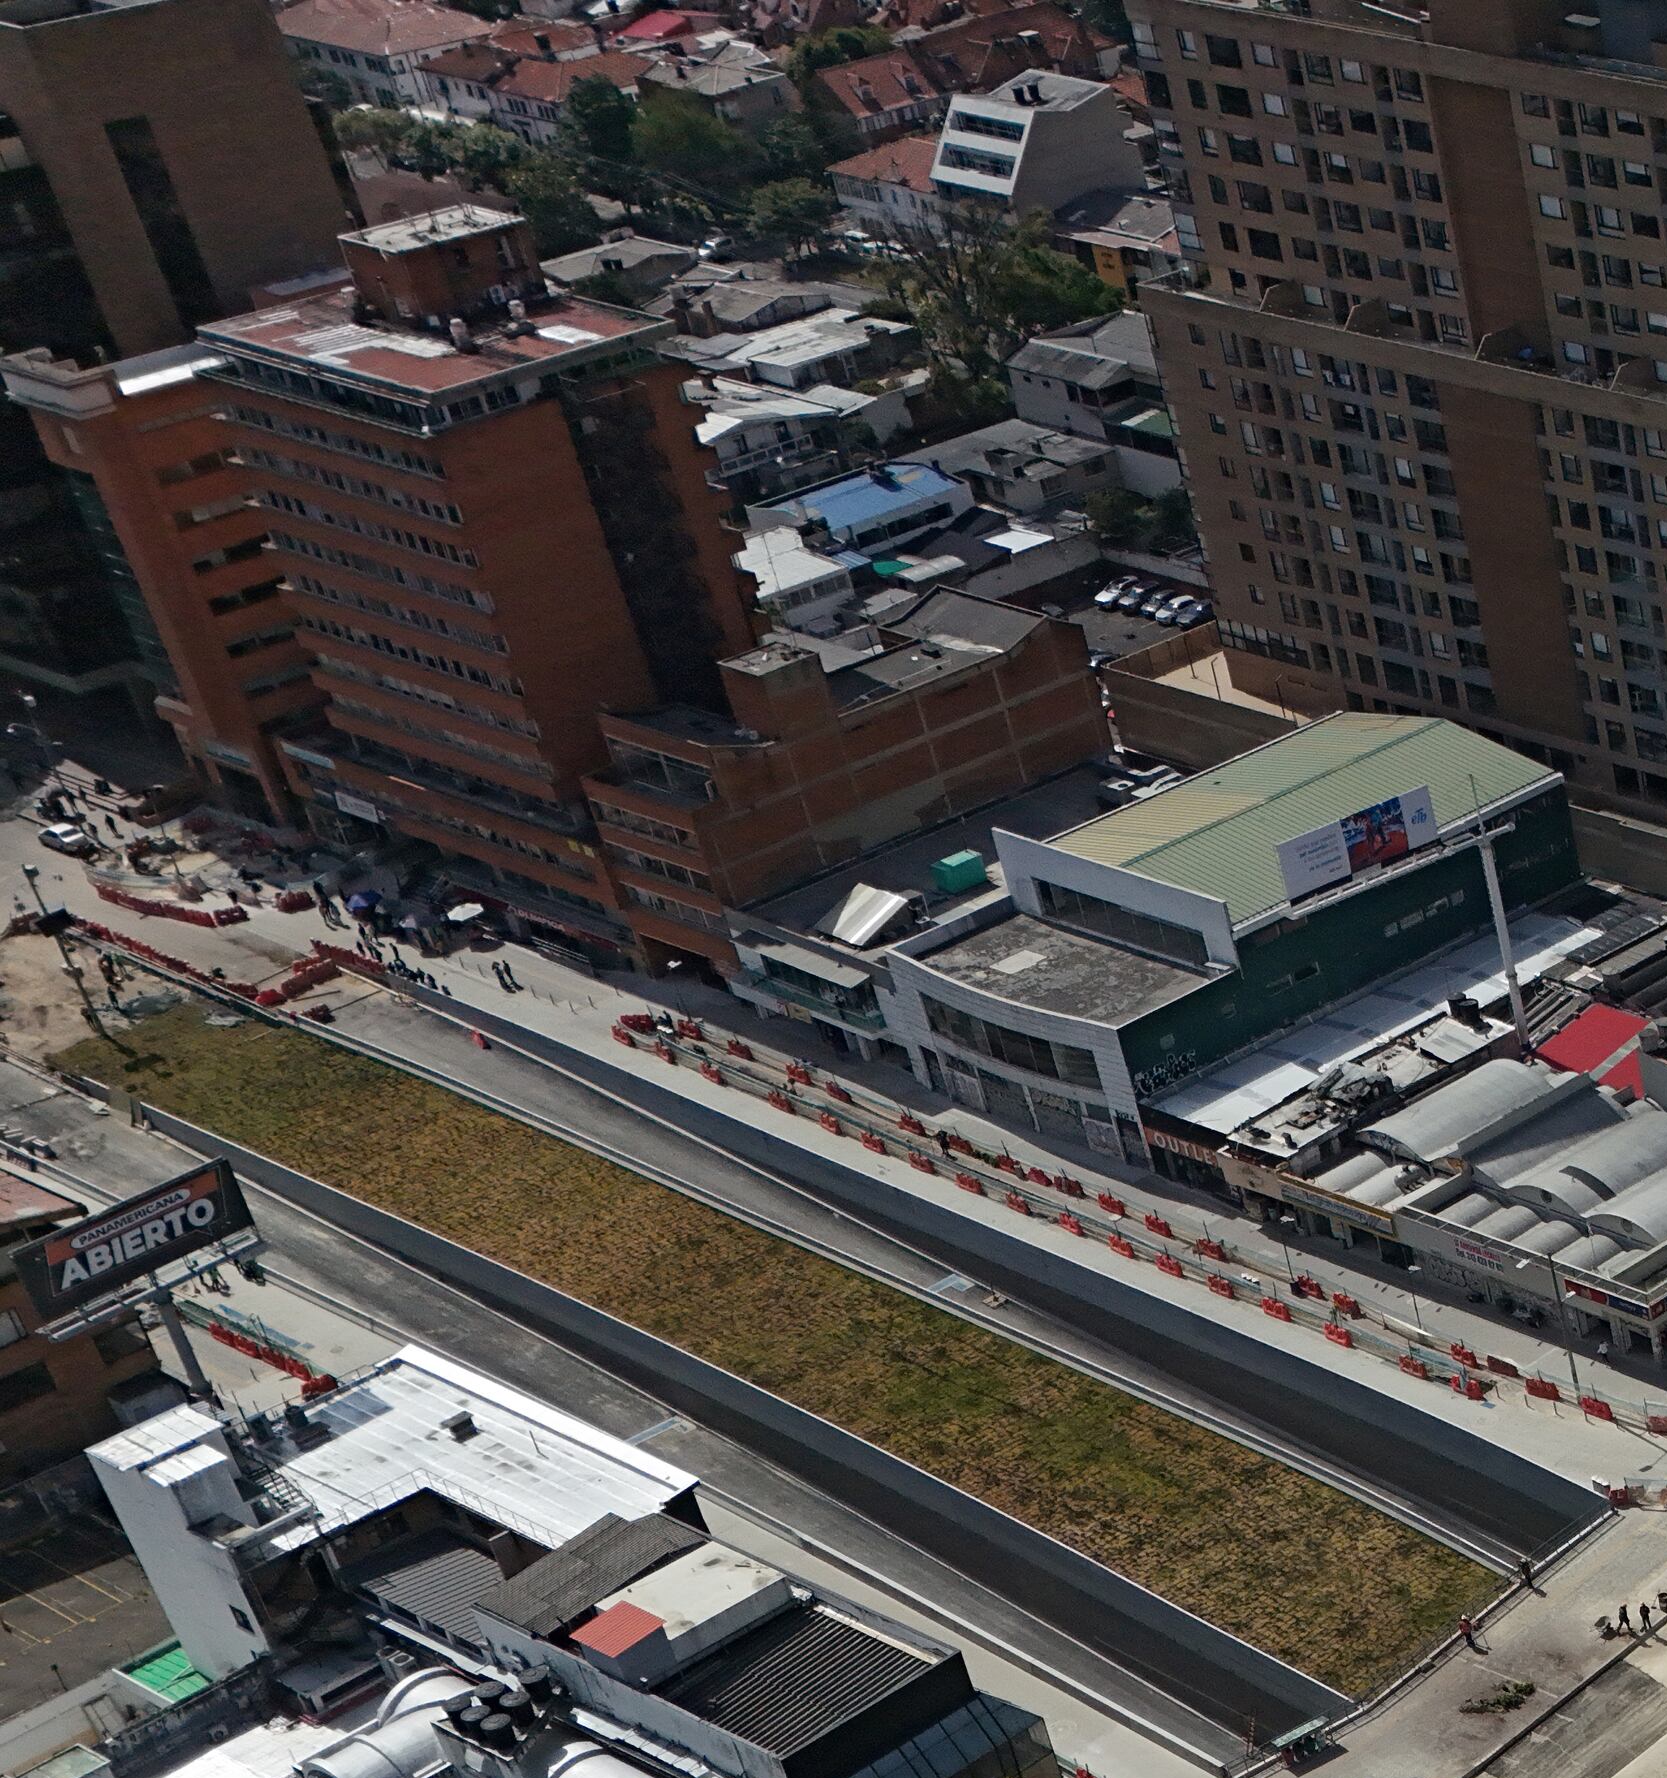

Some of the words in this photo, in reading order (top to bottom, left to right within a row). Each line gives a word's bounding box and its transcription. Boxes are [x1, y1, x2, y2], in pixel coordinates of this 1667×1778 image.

[1154, 1131, 1215, 1166] OUTLE
[60, 1198, 215, 1291] ABIERTO
[78, 1193, 184, 1246] PANAMERICANA
